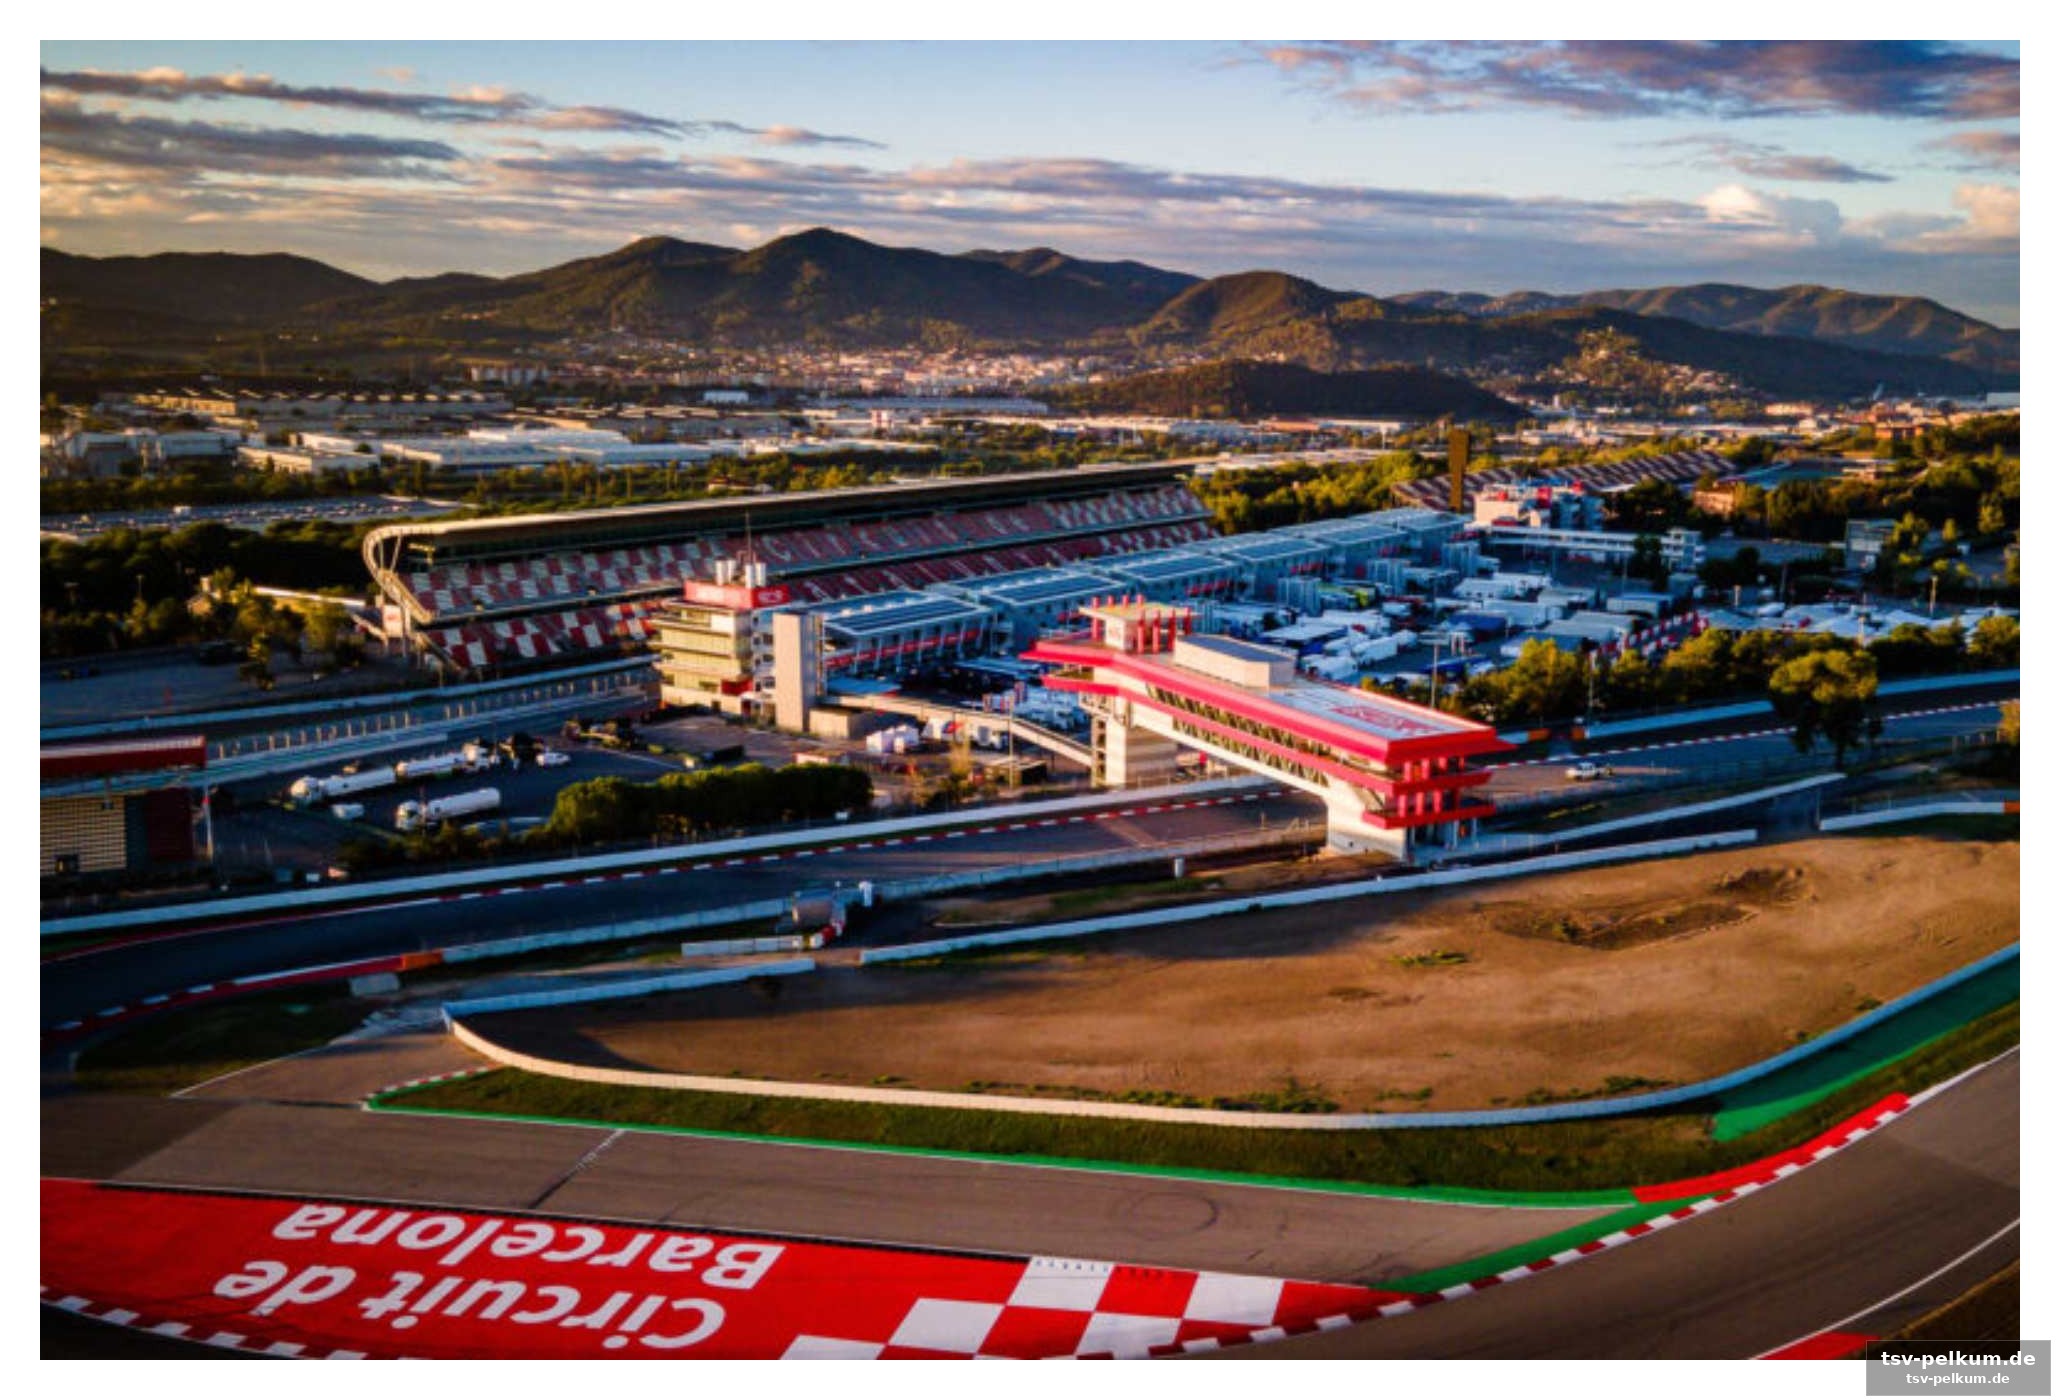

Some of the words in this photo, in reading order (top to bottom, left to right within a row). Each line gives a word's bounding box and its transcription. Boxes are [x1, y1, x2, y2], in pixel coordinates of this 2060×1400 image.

[273, 1205, 786, 1289] Barcelona
[213, 1261, 356, 1316] de
[359, 1271, 725, 1350] Circuit
